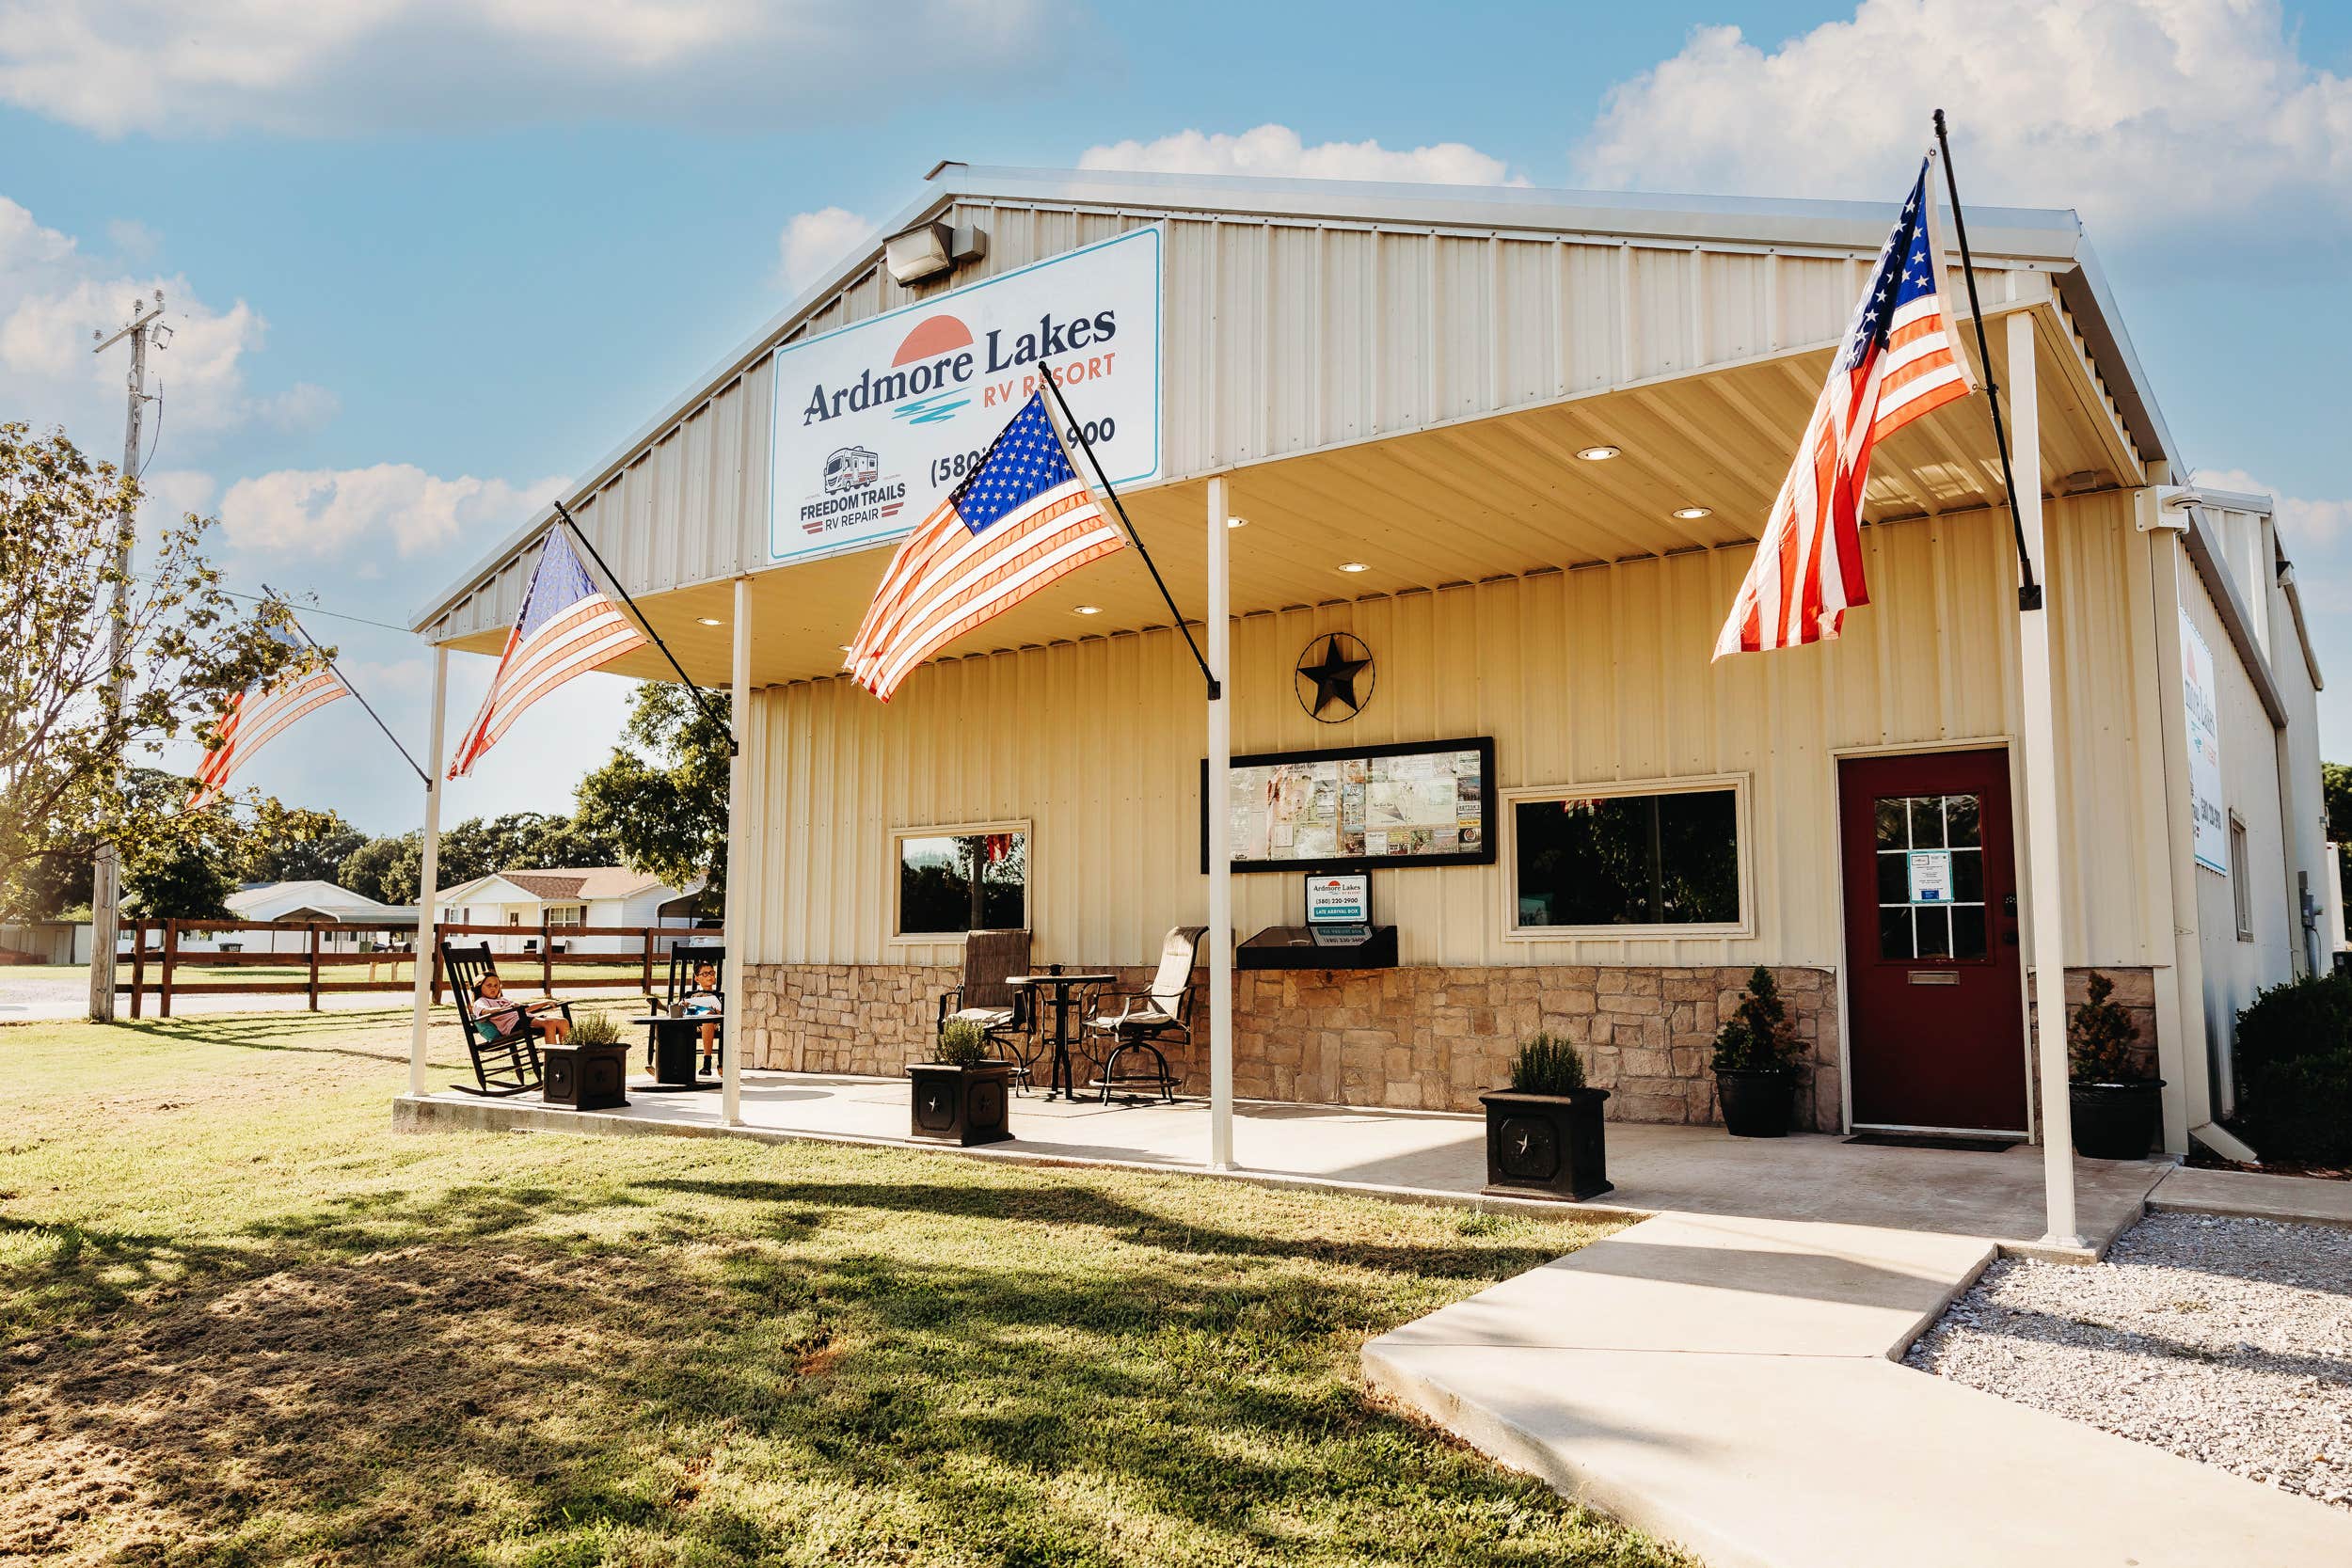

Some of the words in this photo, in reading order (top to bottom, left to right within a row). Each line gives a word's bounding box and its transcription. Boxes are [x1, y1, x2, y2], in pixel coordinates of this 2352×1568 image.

[803, 351, 974, 426] Ardmore
[985, 310, 1116, 374] Lakes
[984, 380, 1014, 408] RV
[931, 446, 987, 488] (580
[801, 493, 859, 521] FREEDOM
[861, 482, 906, 506] TRAILS
[825, 516, 839, 531] RV
[841, 508, 879, 527] REPAIR
